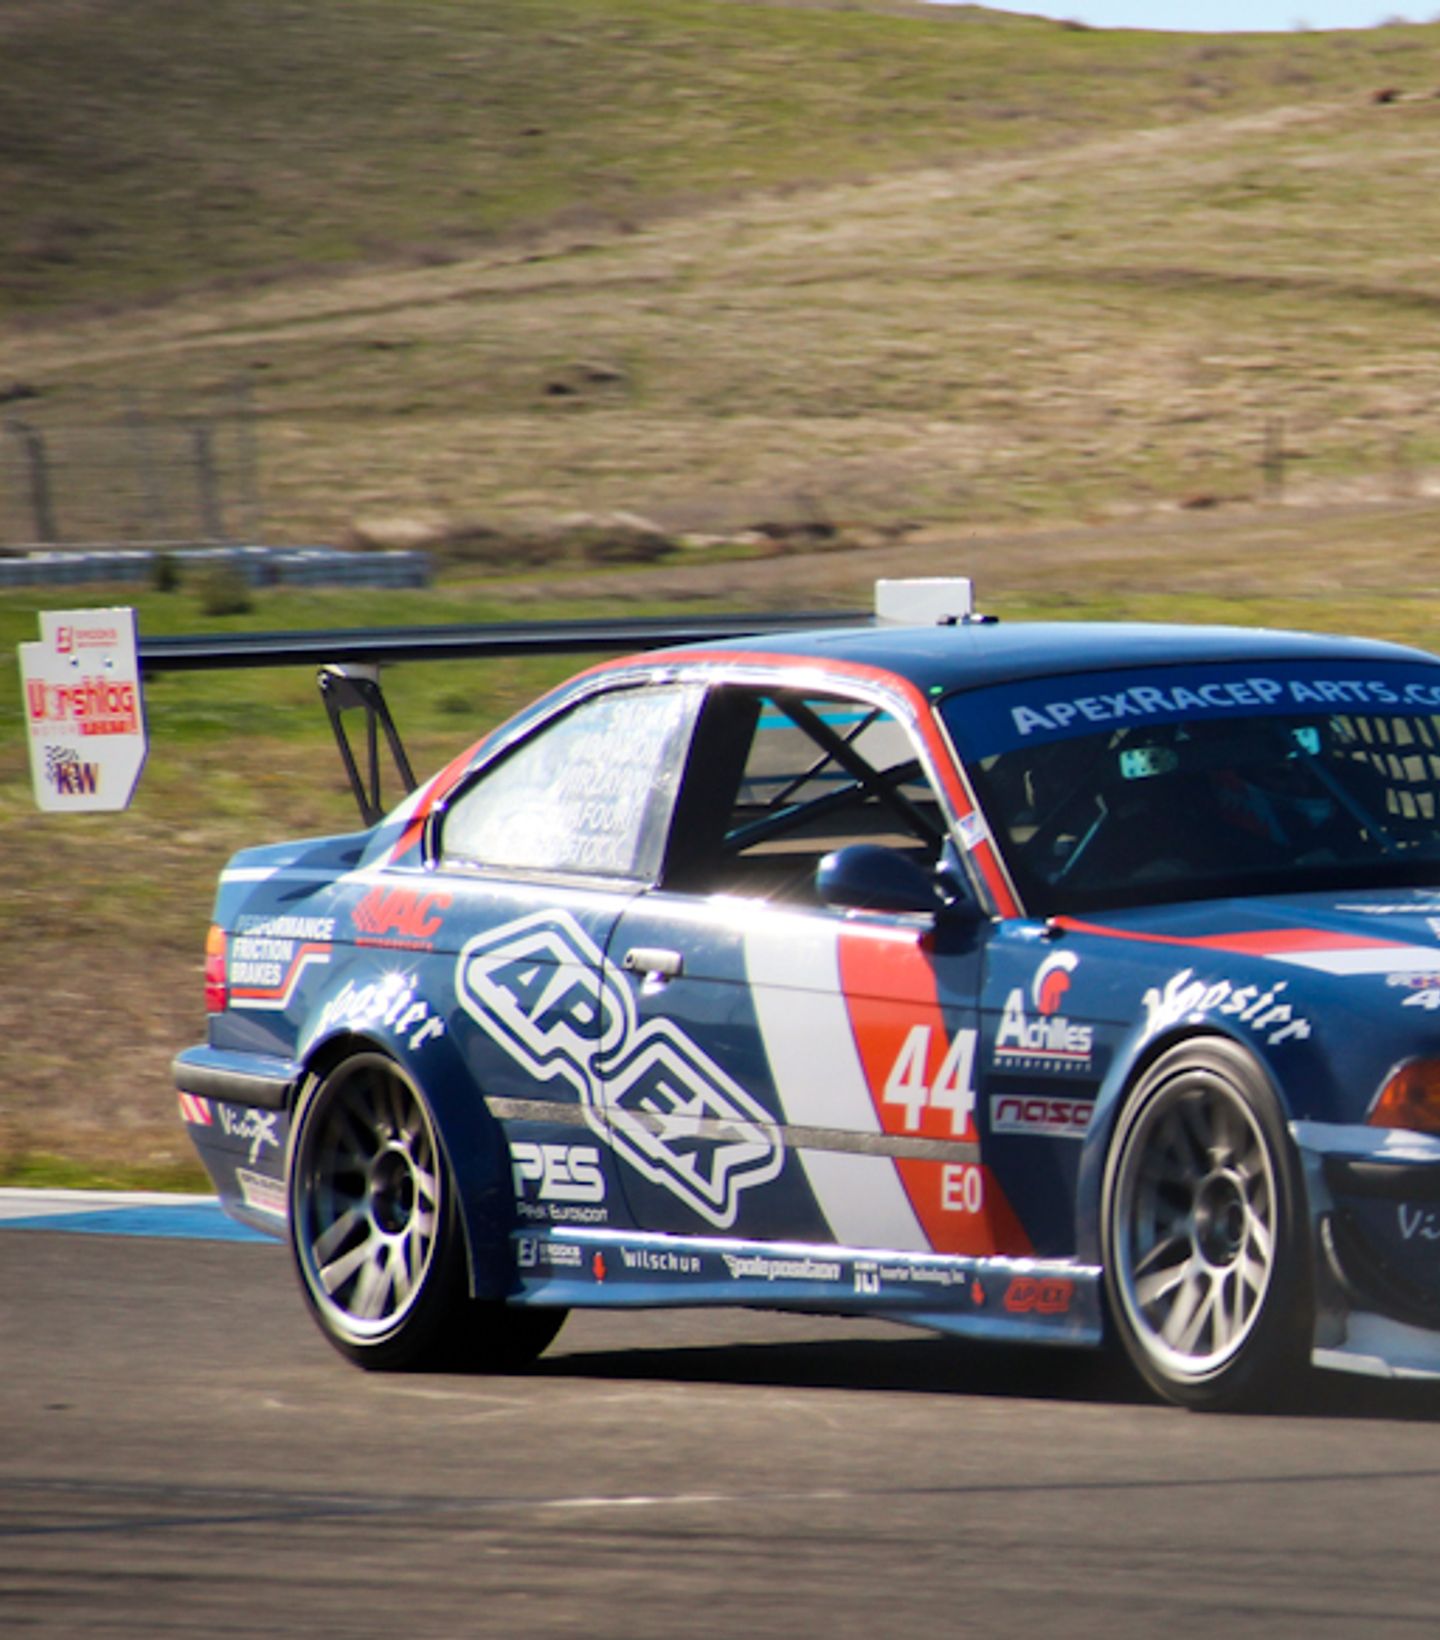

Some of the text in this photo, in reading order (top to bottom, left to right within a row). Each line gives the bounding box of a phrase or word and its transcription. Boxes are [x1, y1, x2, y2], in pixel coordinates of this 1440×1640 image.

[994, 987, 1094, 1052] Achilles
[1136, 967, 1312, 1046] Hoosier
[470, 922, 768, 1208] APEX
[883, 1024, 978, 1135] 44
[509, 1141, 606, 1203] PES
